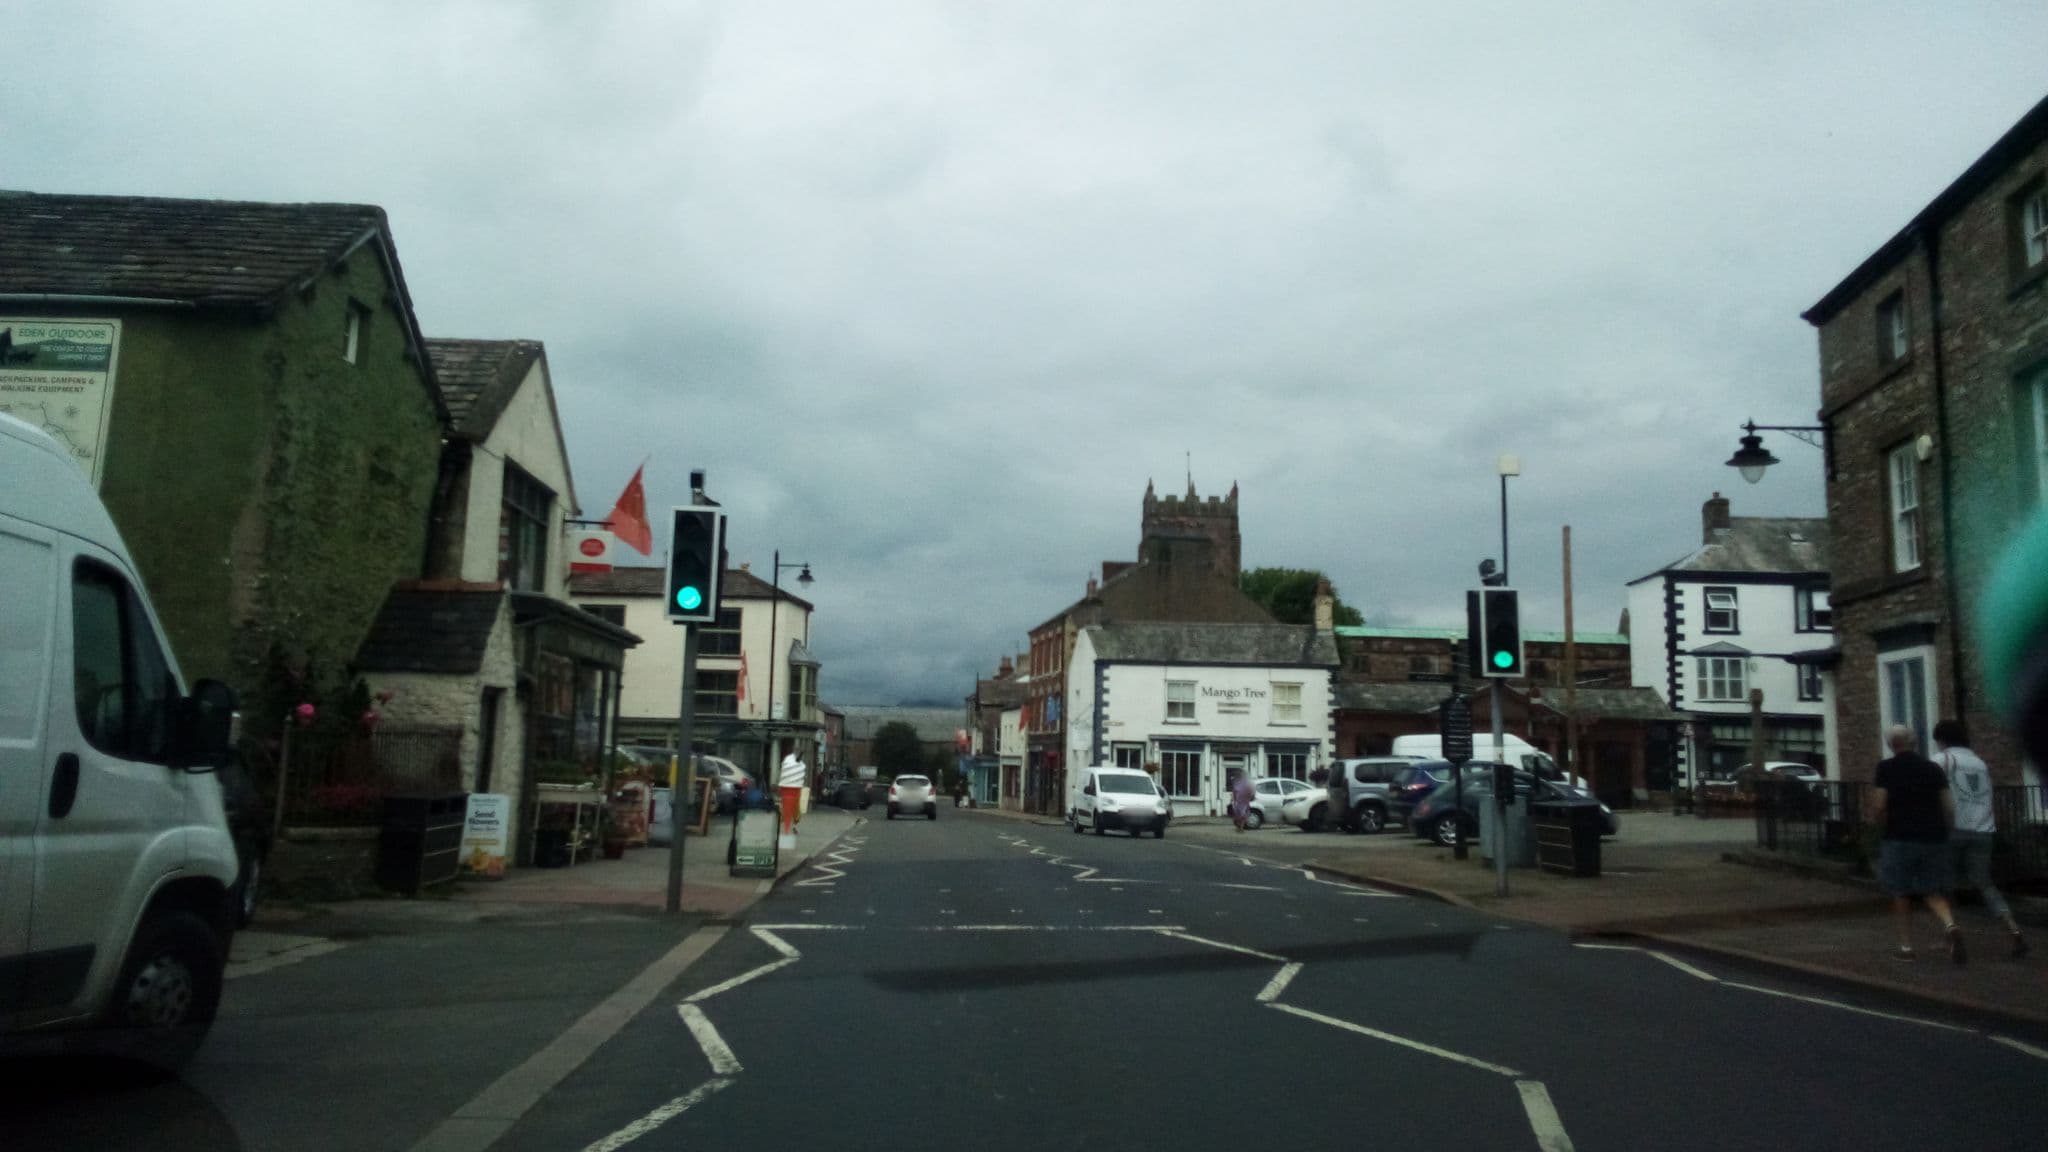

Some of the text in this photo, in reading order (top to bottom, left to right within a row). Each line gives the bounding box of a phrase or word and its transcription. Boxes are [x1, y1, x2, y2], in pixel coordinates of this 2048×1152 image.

[19, 328, 105, 339] EDEN OUTDOORS
[1201, 686, 1266, 699] Mango Tree
